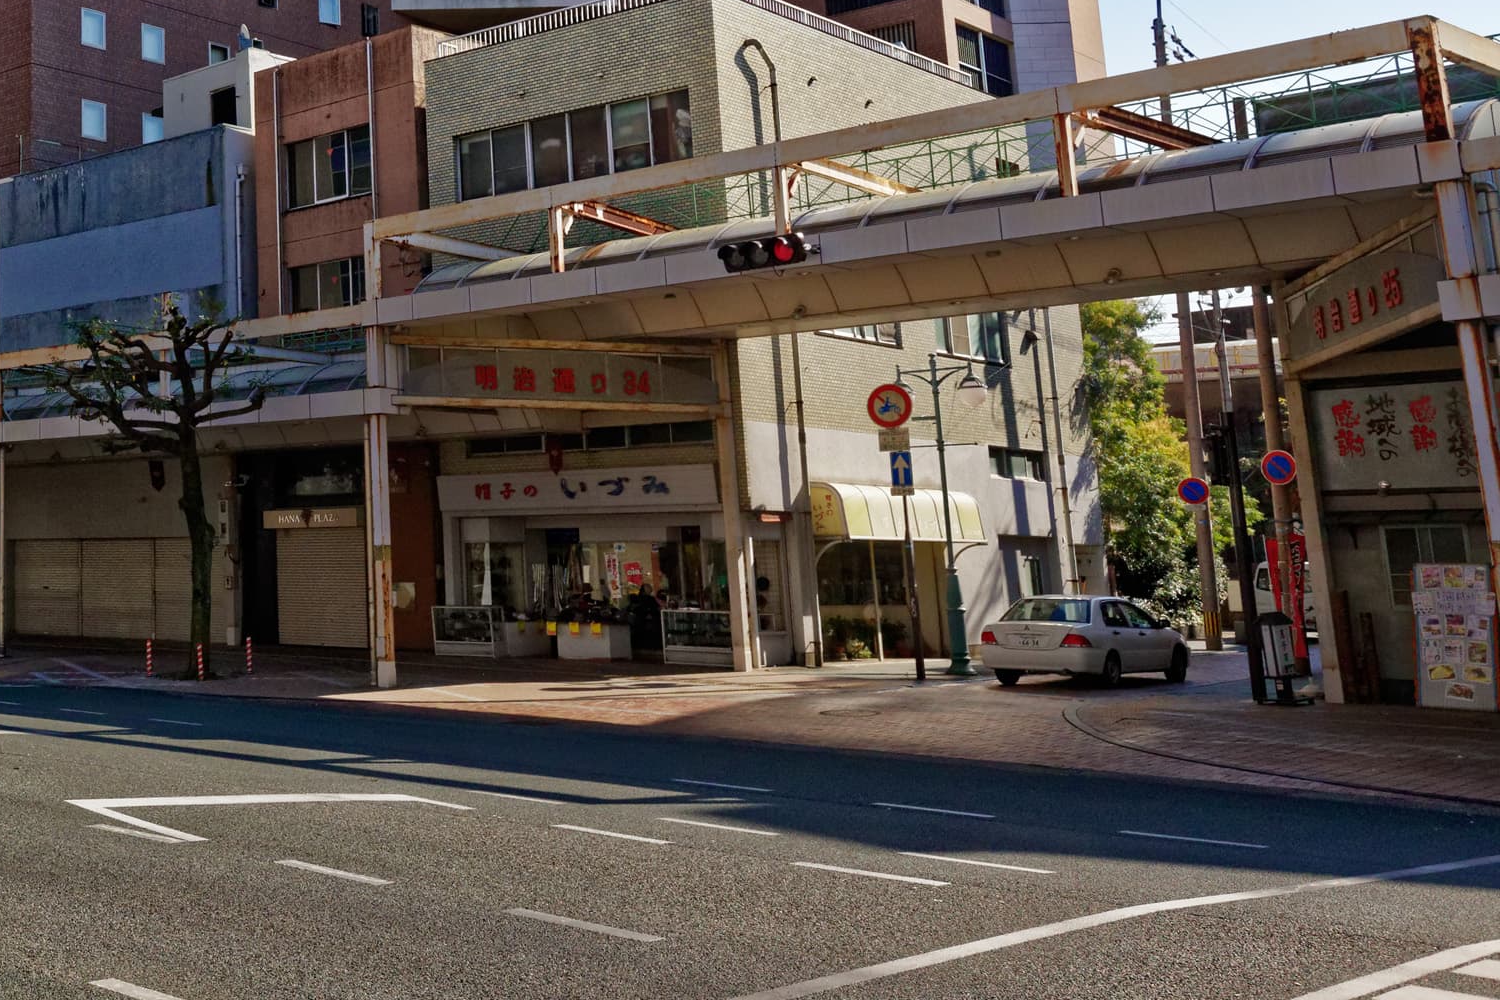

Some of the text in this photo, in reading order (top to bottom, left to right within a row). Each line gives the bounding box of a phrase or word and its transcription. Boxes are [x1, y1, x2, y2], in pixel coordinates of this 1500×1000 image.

[474, 475, 670, 500] 帽子の いづみ
[278, 512, 340, 525] HANA PLAZ
